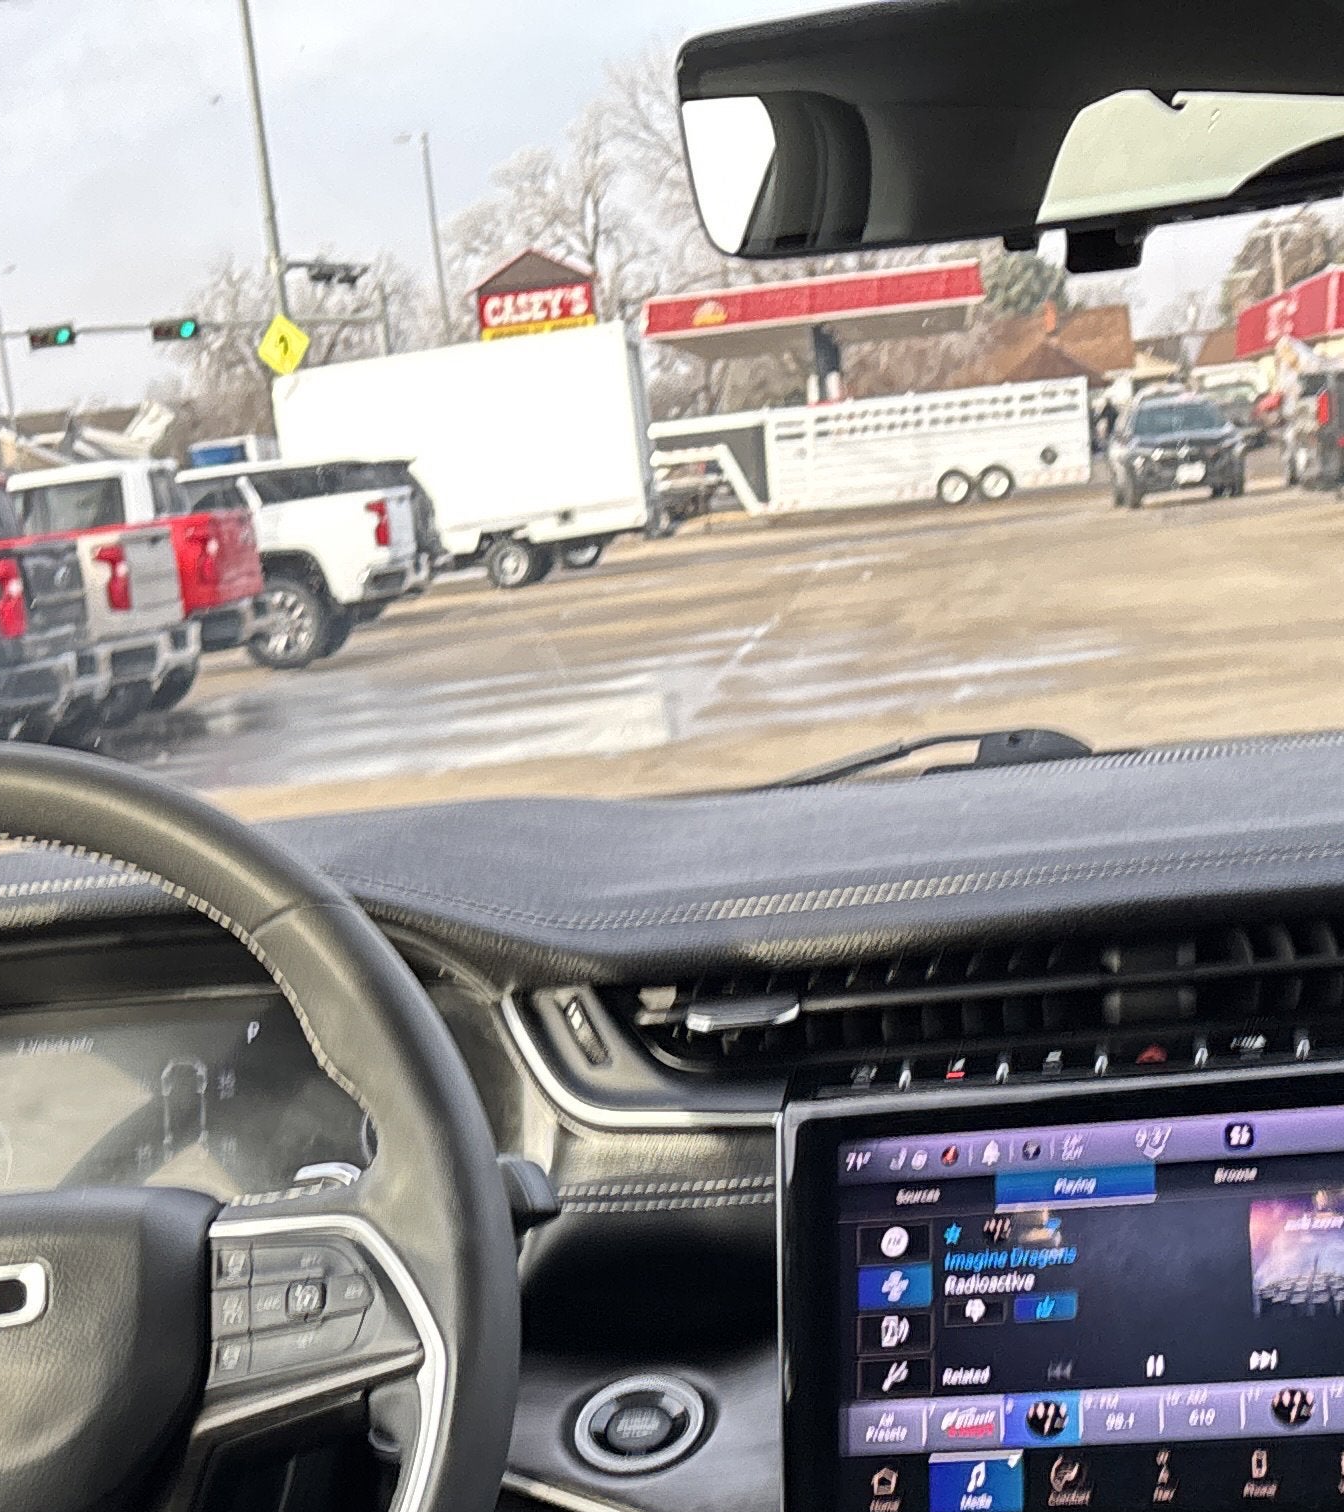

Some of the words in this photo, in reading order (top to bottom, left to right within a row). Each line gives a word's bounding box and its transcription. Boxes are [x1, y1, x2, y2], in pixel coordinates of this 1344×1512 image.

[483, 285, 590, 328] CASEY'S
[1054, 1177, 1097, 1195] Playing
[944, 1250, 1007, 1273] Imagine
[1010, 1246, 1078, 1270] Dragons
[944, 1273, 1036, 1297] Radioactive
[942, 1366, 991, 1387] Related
